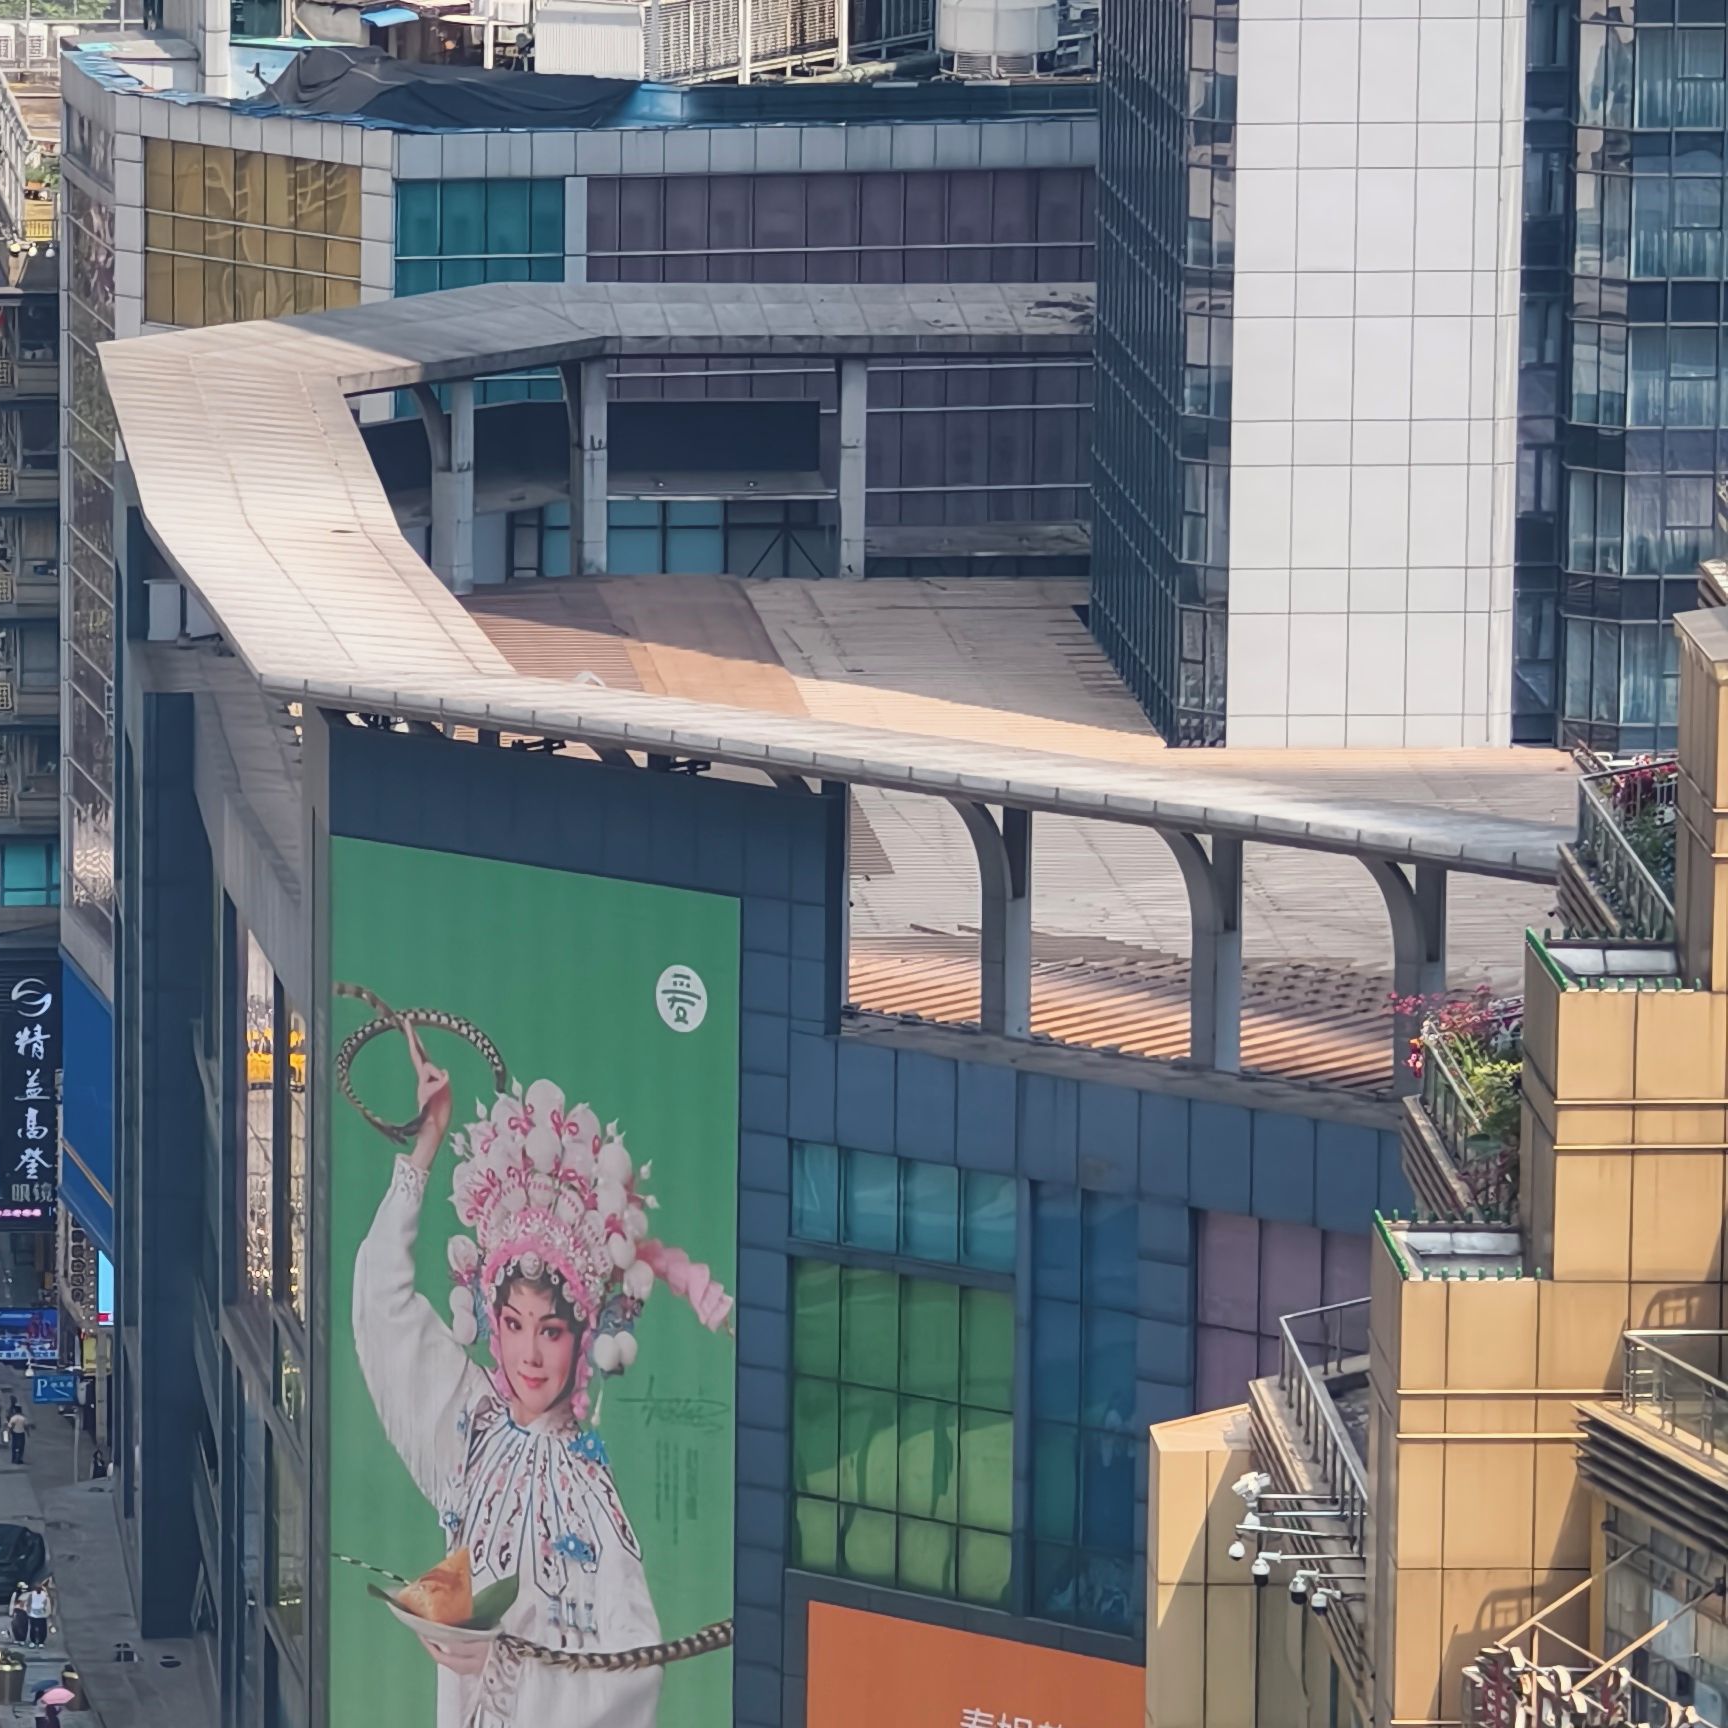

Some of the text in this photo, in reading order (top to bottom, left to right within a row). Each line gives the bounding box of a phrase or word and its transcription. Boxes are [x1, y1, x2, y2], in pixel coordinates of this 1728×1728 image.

[14, 1023, 53, 1180] 精益高登
[36, 1379, 48, 1397] P
